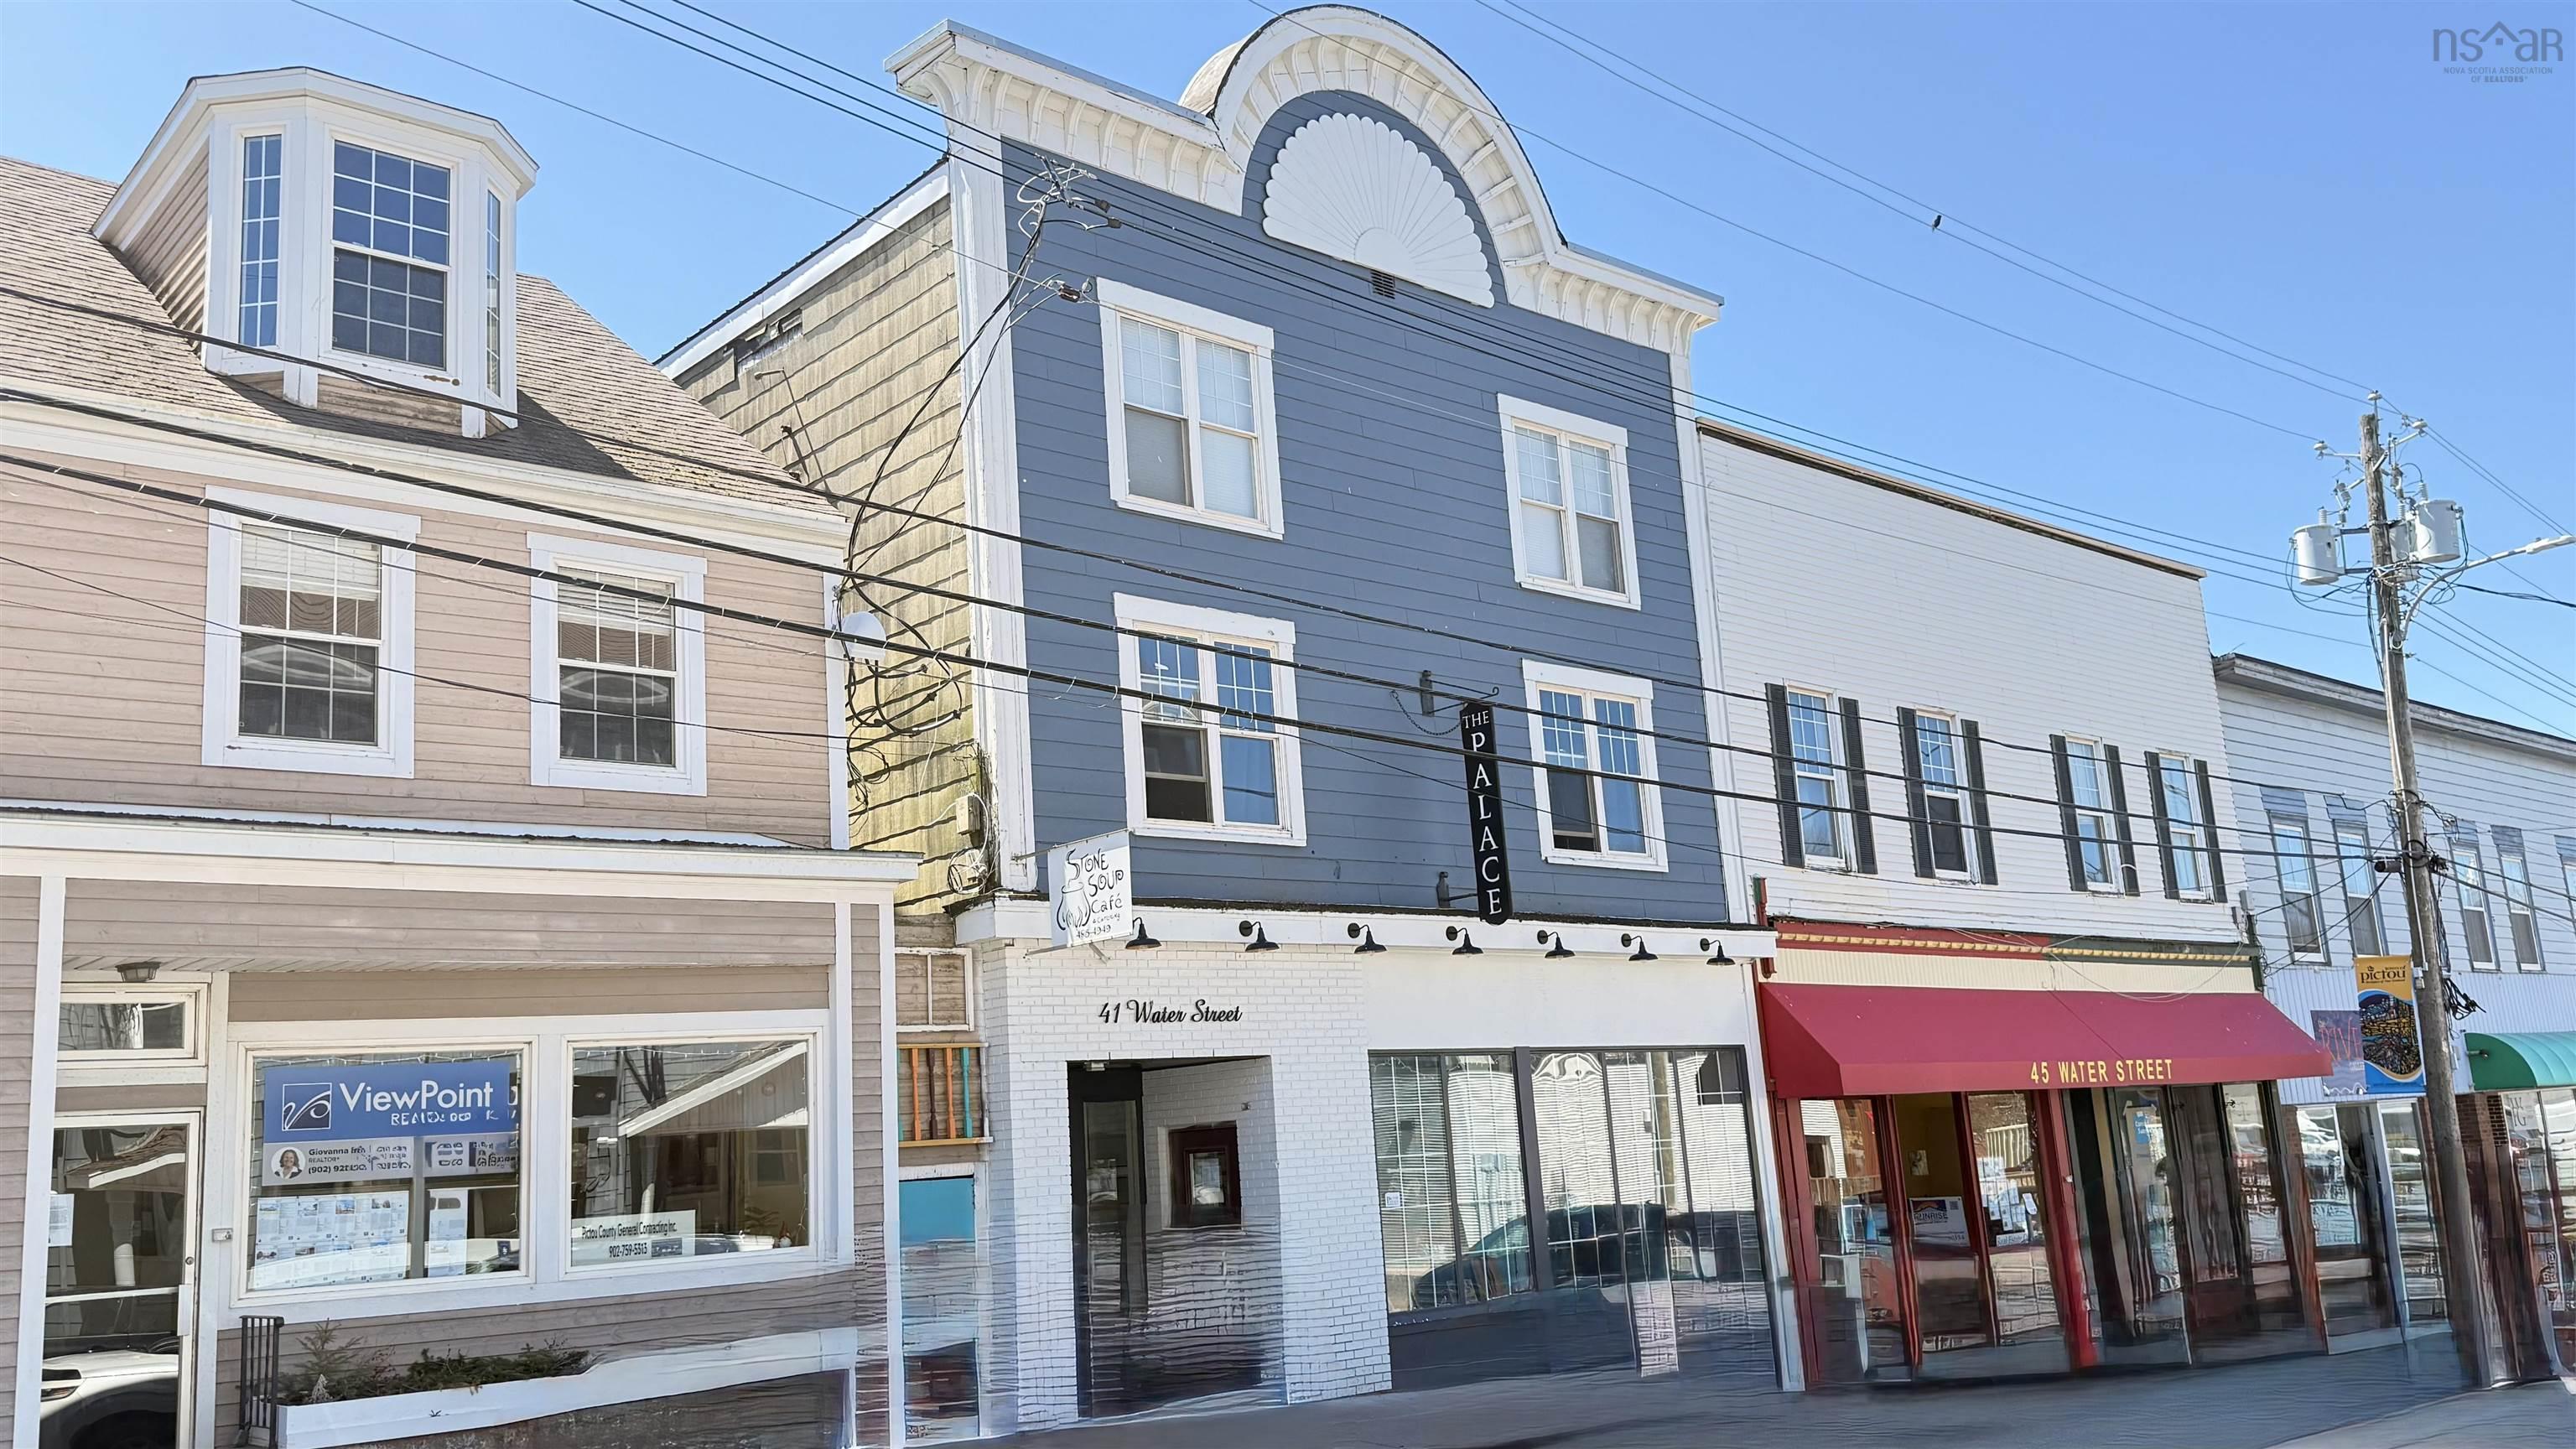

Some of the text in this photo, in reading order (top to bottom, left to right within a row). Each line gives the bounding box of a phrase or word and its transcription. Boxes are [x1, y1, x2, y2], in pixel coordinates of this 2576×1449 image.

[1462, 710, 1490, 729] THE
[1471, 731, 1503, 916] PALACE
[1066, 848, 1109, 880] STONE
[1088, 870, 1124, 897] SOUP
[1091, 892, 1123, 914] Café
[2360, 969, 2406, 984] pictou
[1098, 999, 1243, 1024] 41 Water Street
[2030, 1058, 2173, 1083] 45 WATER STREET
[339, 1080, 494, 1113] ViewPoint
[309, 1147, 349, 1156] Giovanna
[308, 1165, 331, 1175] (902)
[617, 1223, 639, 1237] General
